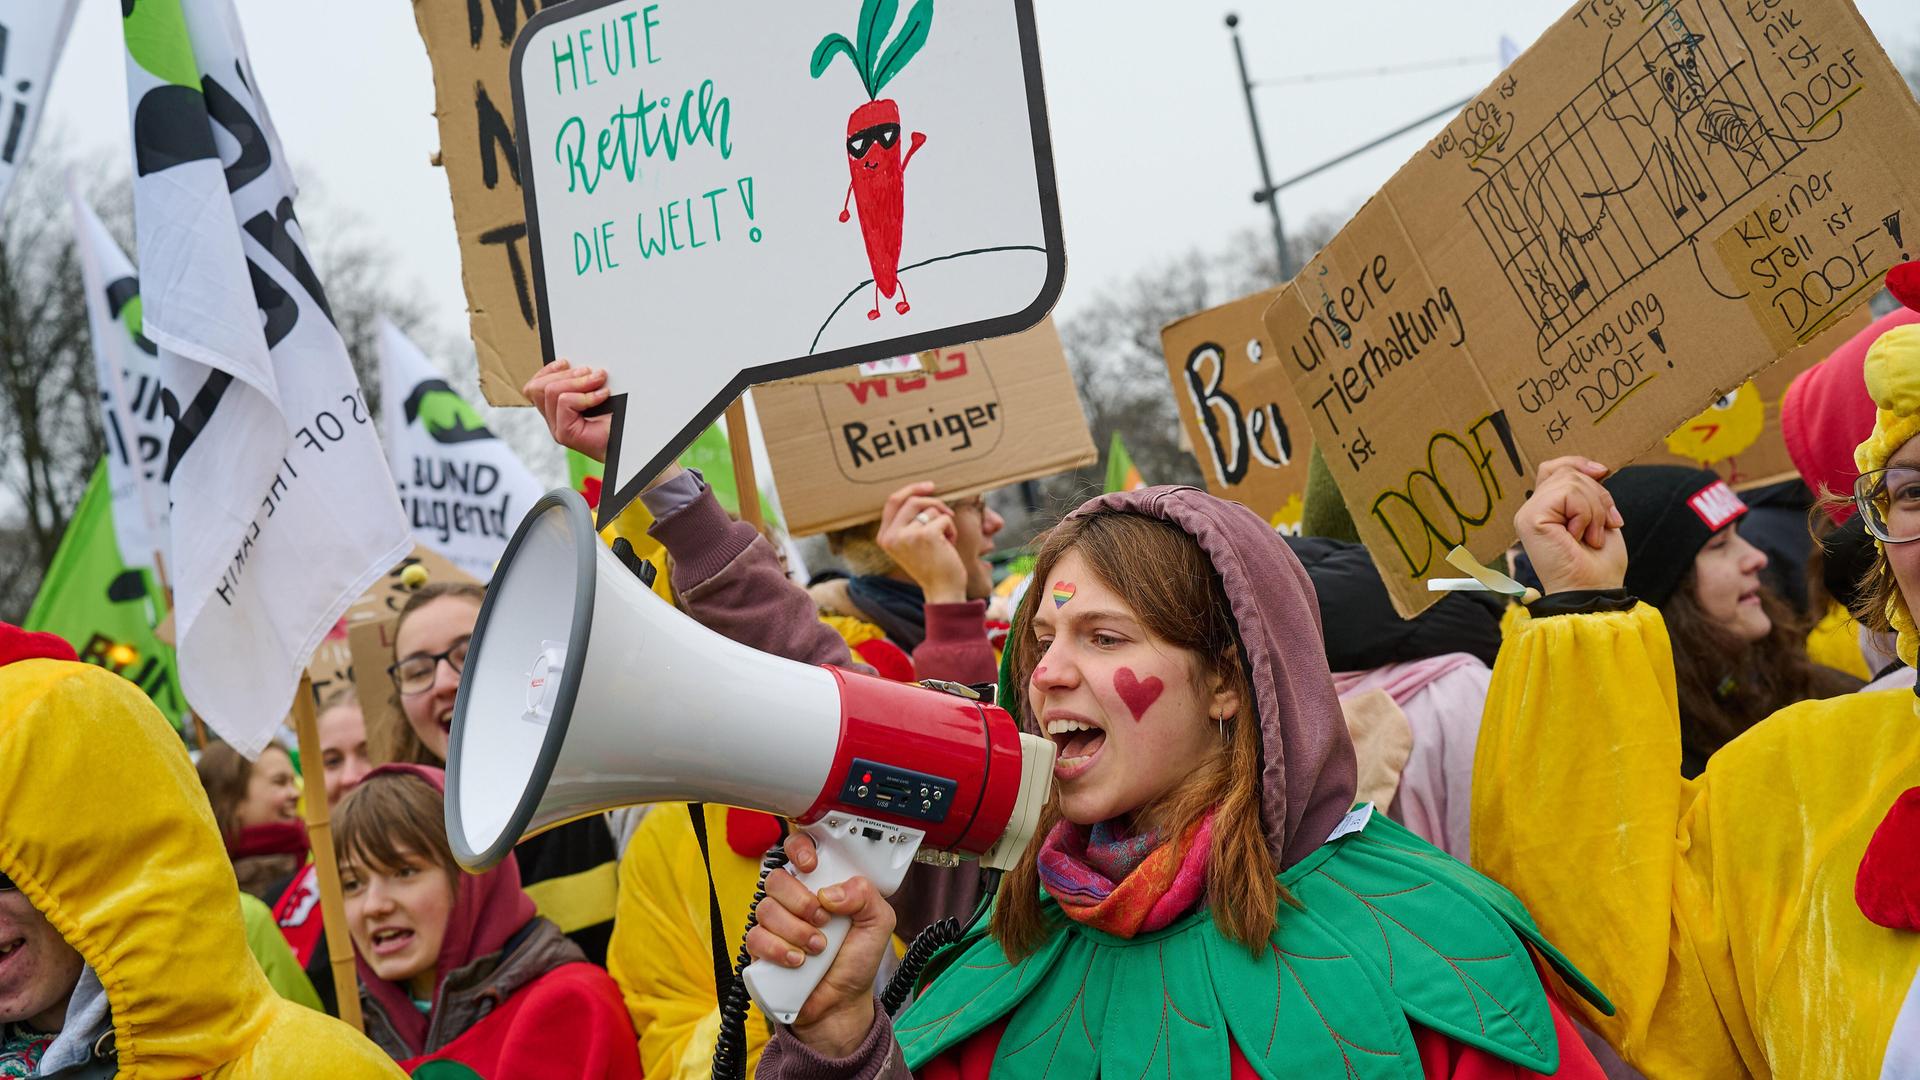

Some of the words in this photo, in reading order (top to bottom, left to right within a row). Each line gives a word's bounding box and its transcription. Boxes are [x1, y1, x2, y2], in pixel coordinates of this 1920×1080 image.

[553, 4, 662, 95] HEUTE
[1603, 5, 1626, 30] ist
[1764, 9, 1802, 48] nik
[1772, 35, 1822, 80] ist
[1780, 48, 1863, 128] DOOF
[556, 79, 732, 195] Rettich
[1430, 127, 1458, 159] viel
[1496, 74, 1518, 100] ist
[1459, 111, 1502, 158] DOOF
[574, 221, 619, 276] DIE
[638, 176, 762, 259] WELT!
[1823, 202, 1853, 236] ist
[1292, 255, 1396, 371] unsere
[1312, 287, 1465, 435] Tierhaltung
[843, 402, 999, 469] Reiniger
[1342, 427, 1376, 472] ist
[1542, 410, 1572, 445] ist
